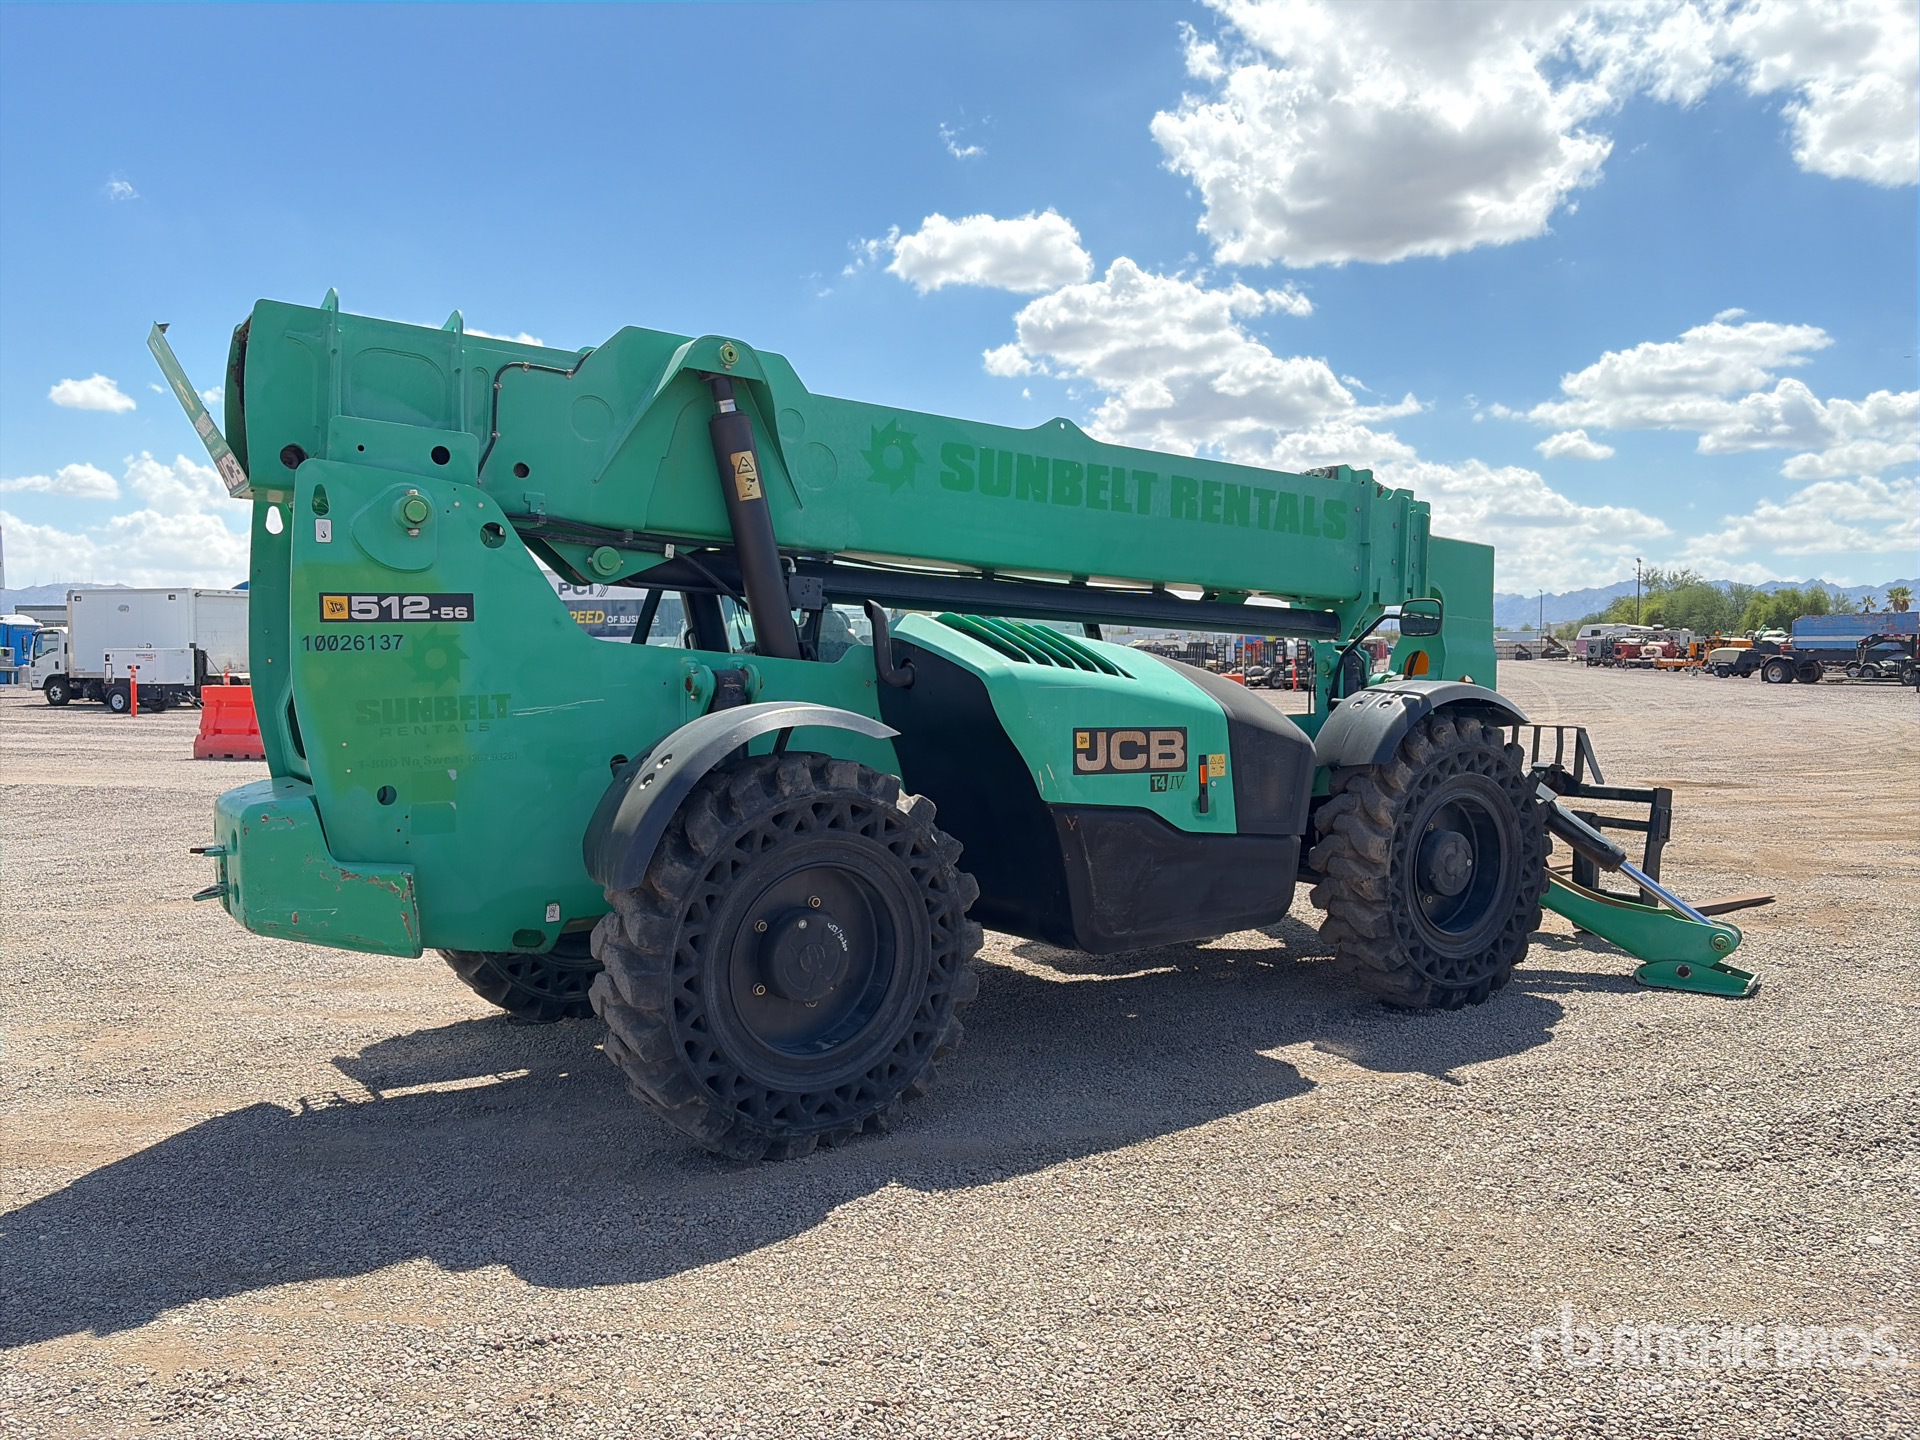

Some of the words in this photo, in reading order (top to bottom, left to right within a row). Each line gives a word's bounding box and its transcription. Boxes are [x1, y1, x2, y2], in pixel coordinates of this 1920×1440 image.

[216, 452, 245, 489] JCB
[939, 441, 1158, 516] SUNBELT
[1170, 474, 1348, 541] RENTALS
[558, 582, 594, 595] PCI
[326, 601, 346, 615] JCB
[350, 595, 468, 620] 512-56
[570, 610, 605, 624] PEED
[302, 634, 404, 651] 10026137
[355, 693, 512, 726] SUNBELT
[379, 722, 491, 738] RENTALS
[1076, 731, 1185, 771] JCB
[1151, 775, 1167, 791] T4
